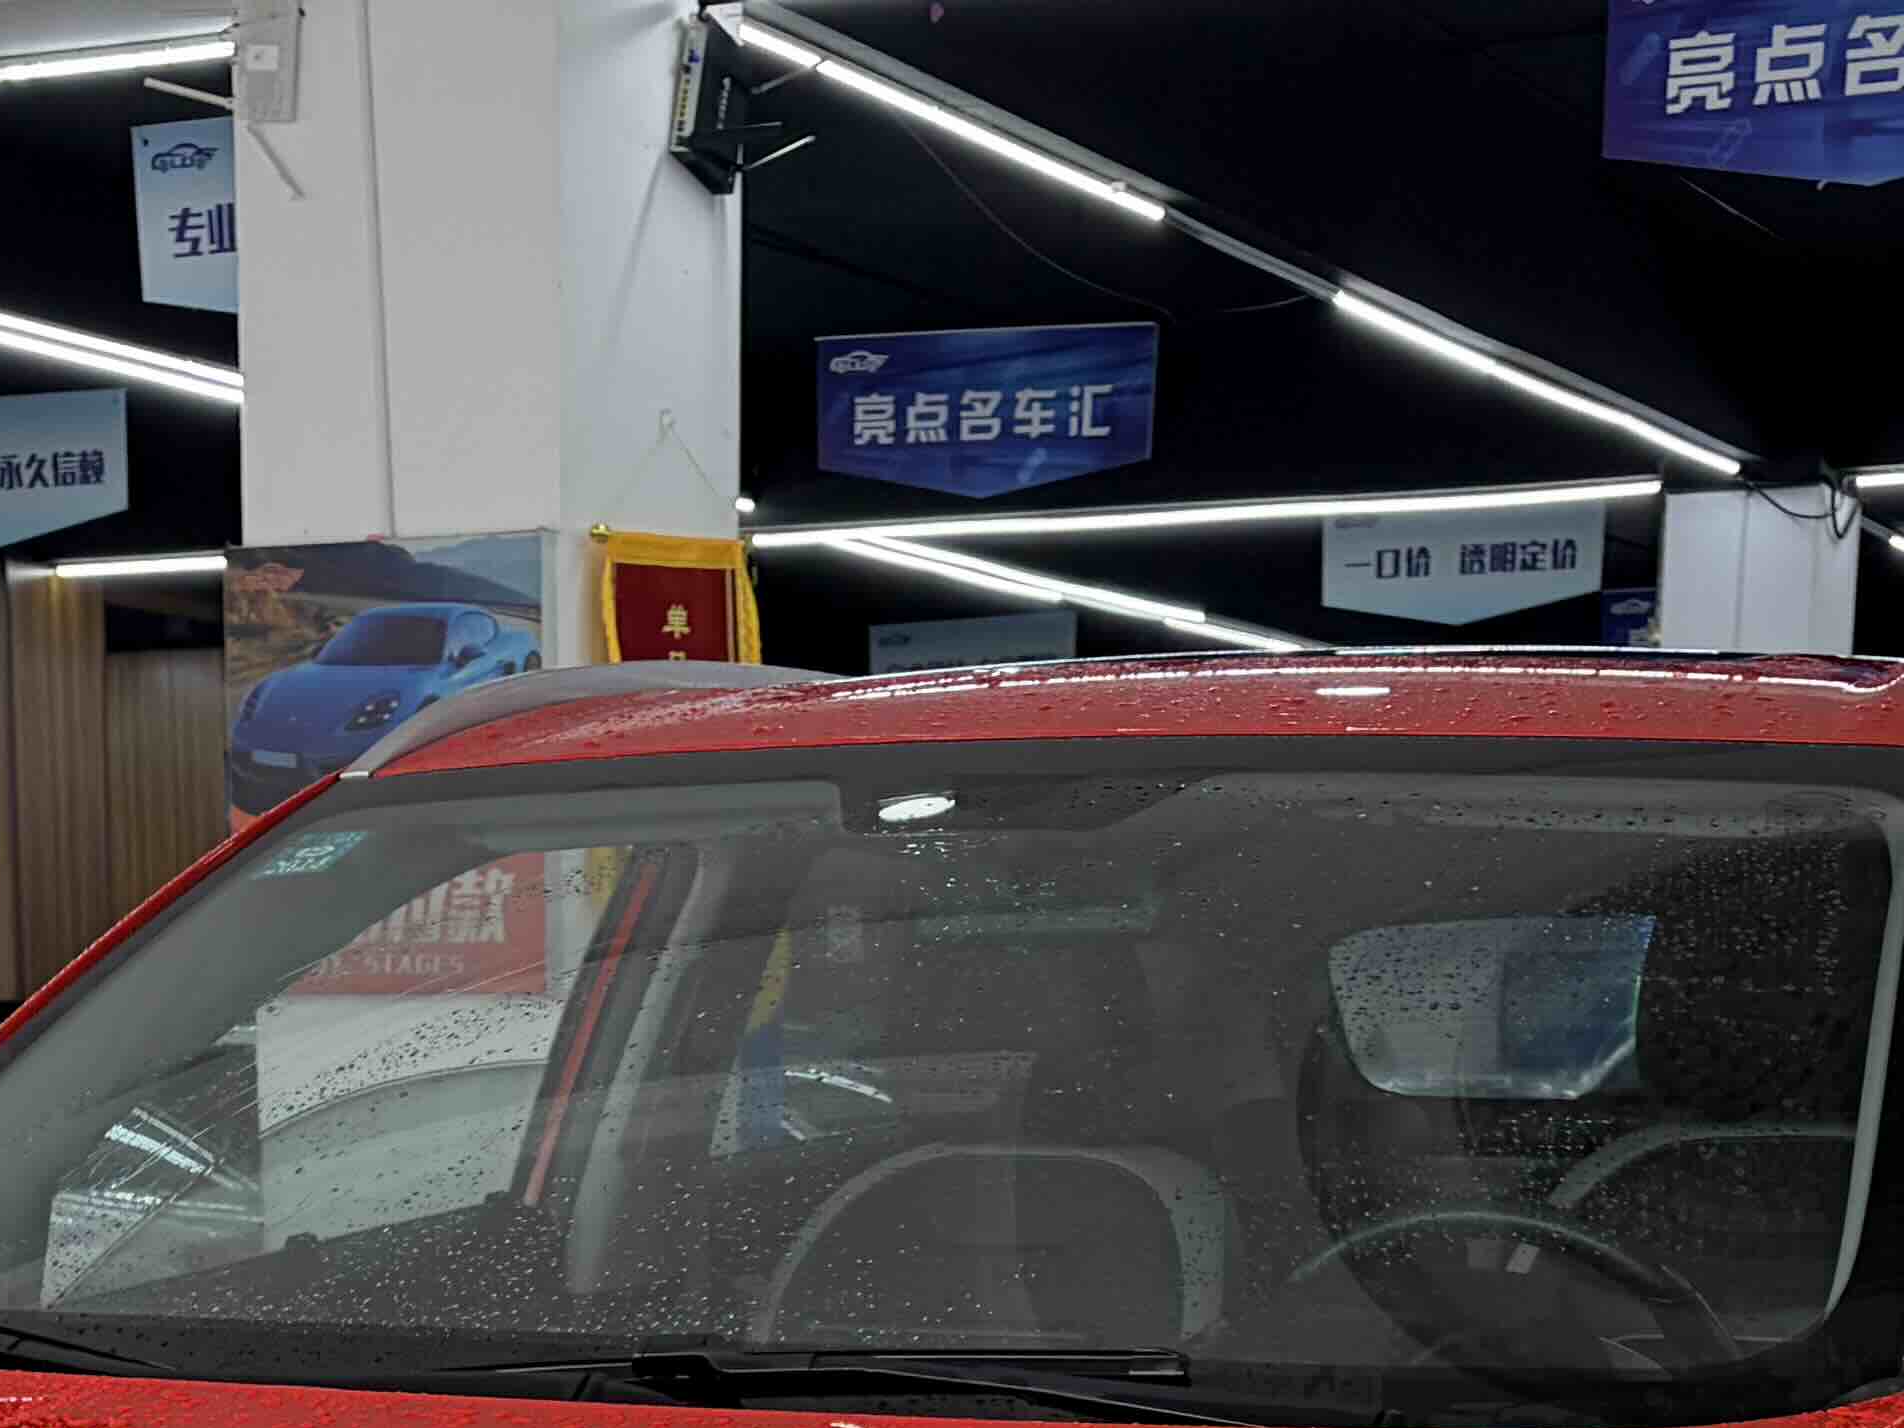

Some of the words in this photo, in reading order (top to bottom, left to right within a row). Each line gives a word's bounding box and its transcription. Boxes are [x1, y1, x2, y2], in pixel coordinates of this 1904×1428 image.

[852, 384, 1114, 446] 亮点名车汇
[1345, 545, 1432, 579] 一口价
[1458, 538, 1577, 576] 透明定价
